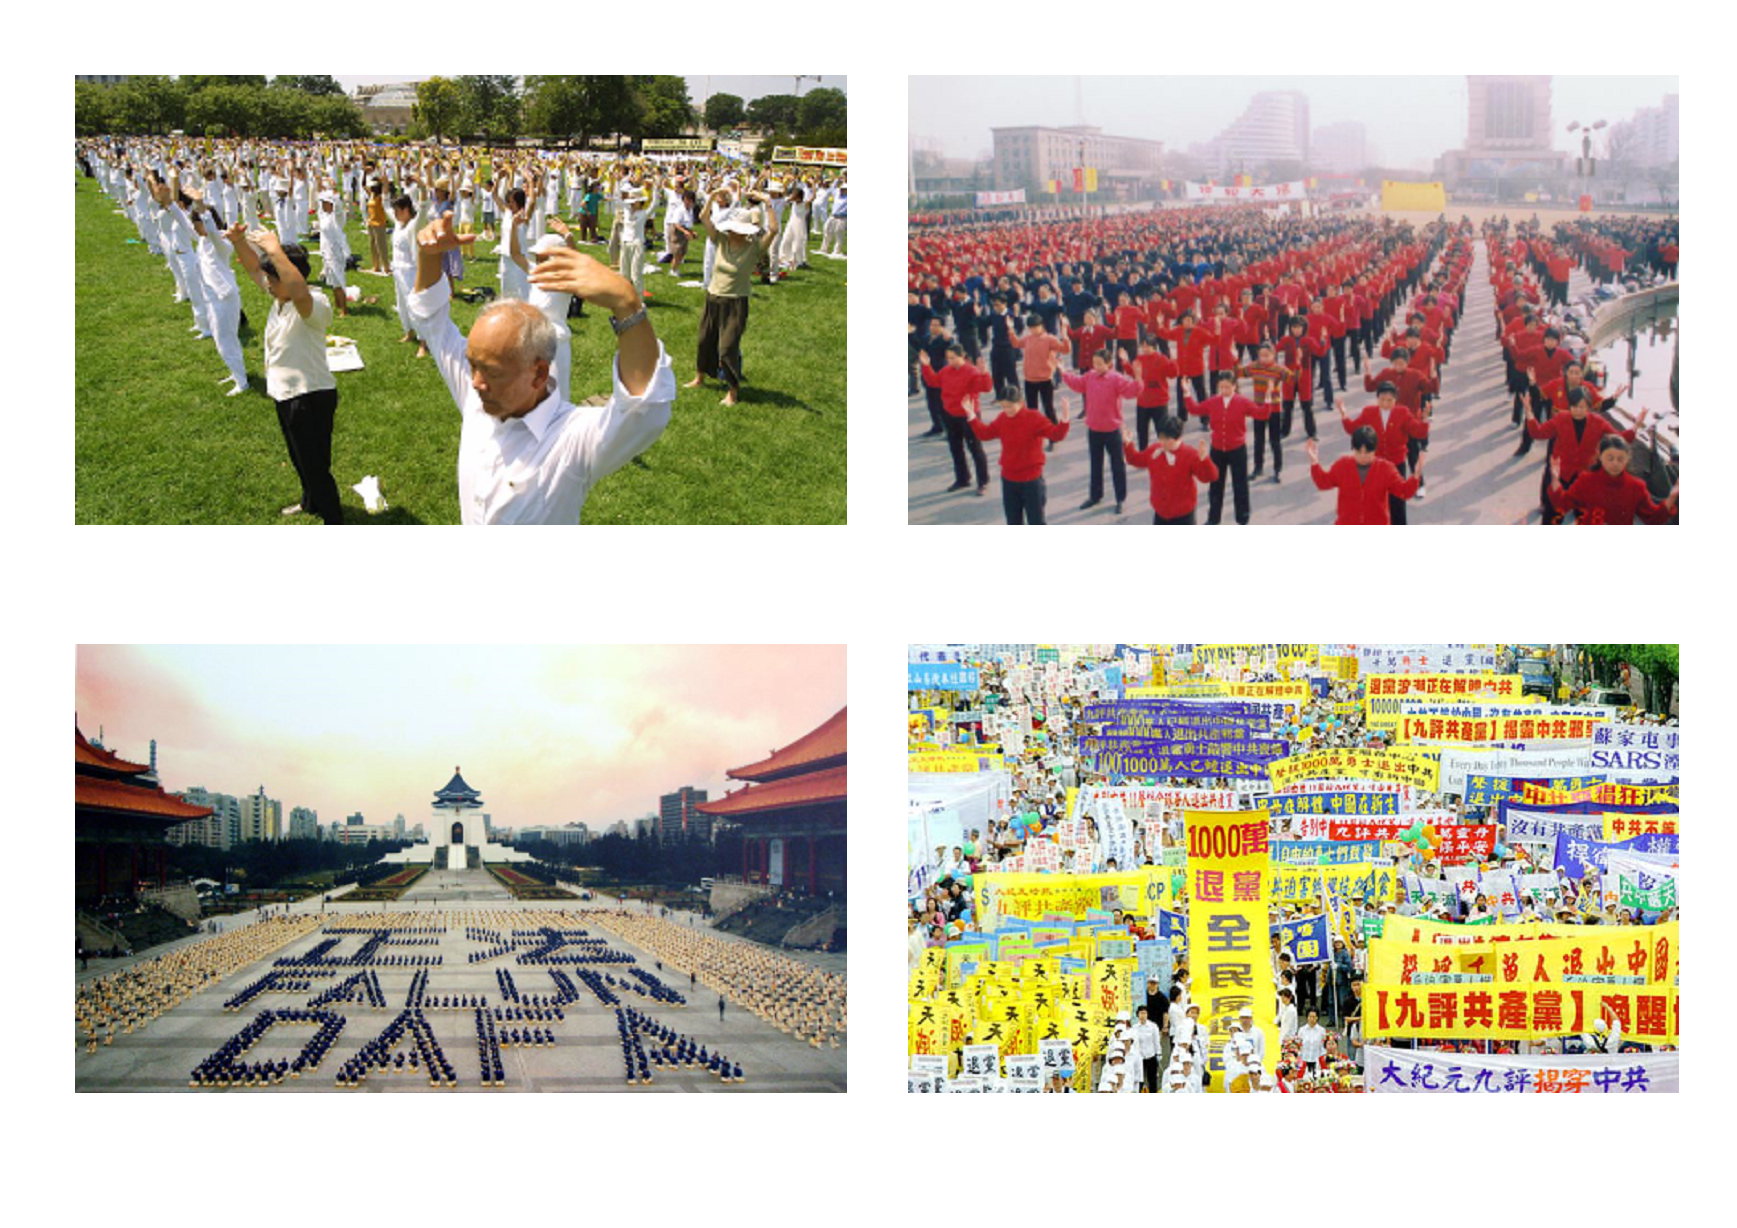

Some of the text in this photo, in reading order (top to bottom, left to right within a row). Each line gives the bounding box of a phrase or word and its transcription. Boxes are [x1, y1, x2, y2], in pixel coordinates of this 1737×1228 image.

[1123, 757, 1265, 776] 1000萬人已經退出中
[1591, 750, 1662, 770] SARS
[1187, 820, 1269, 859] 1000萬
[1194, 869, 1262, 902] 退黨
[1461, 879, 1477, 893] 共
[222, 967, 687, 1012] FALUN
[1376, 990, 1679, 1035] 【九評共產黨】喚醒
[188, 1006, 747, 1087] DAFA
[1379, 1059, 1651, 1093] 大紀元九評揭穿中共
